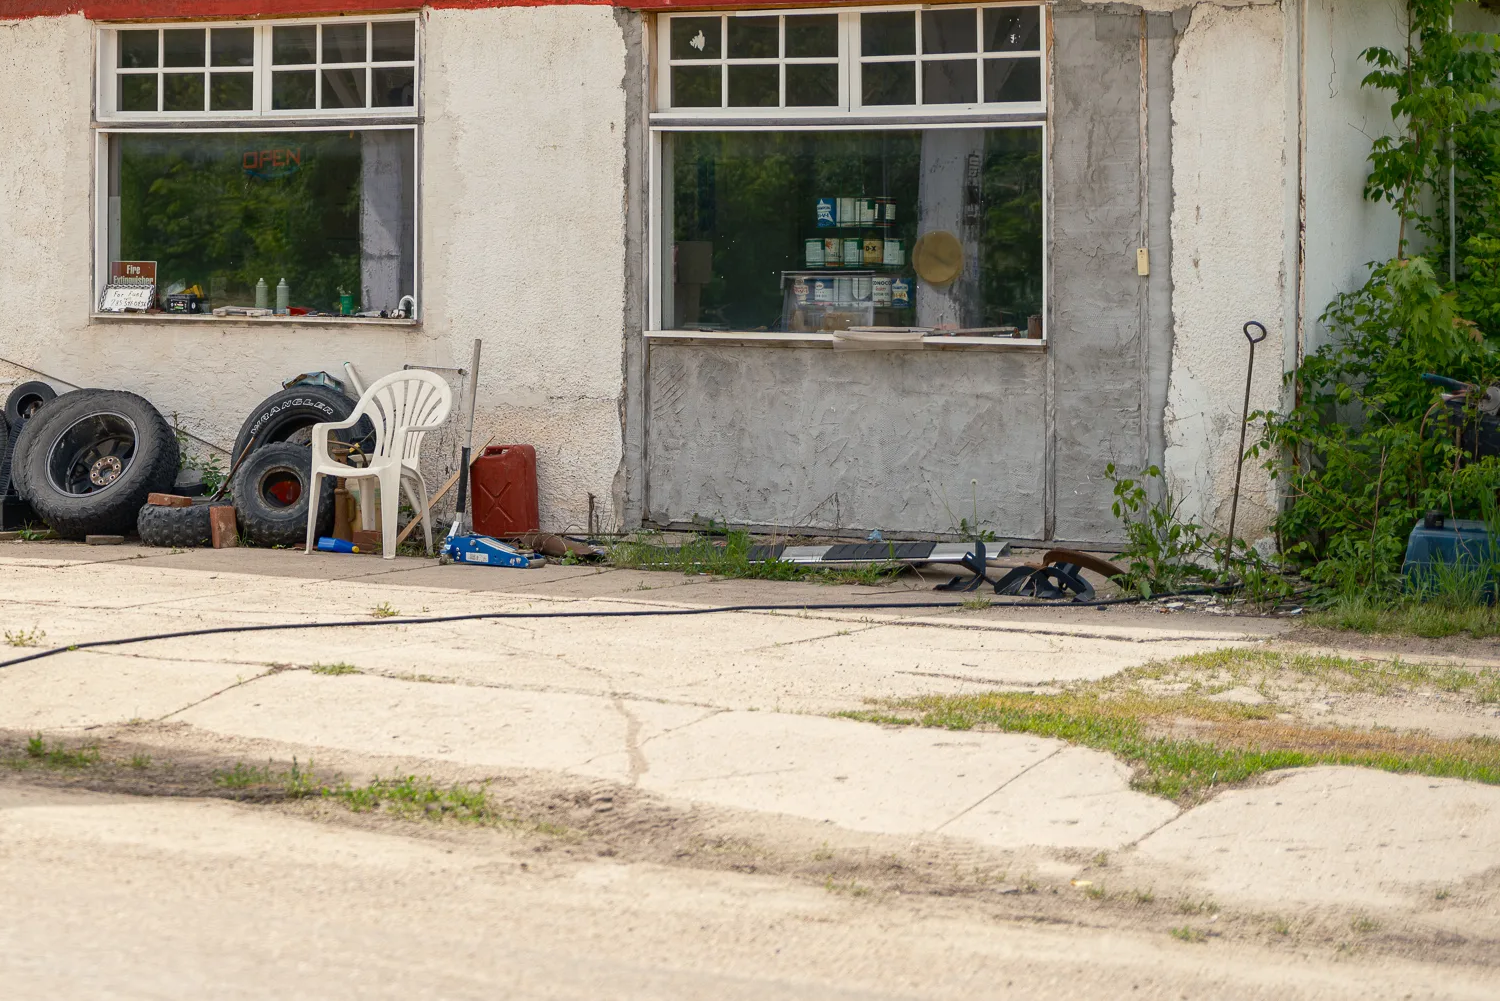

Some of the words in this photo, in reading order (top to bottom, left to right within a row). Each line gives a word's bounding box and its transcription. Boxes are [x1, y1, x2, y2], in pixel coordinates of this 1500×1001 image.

[243, 148, 301, 169] OPEN
[126, 264, 141, 275] Fire
[113, 275, 154, 285] Extinguisher
[250, 398, 334, 435] WRANGLER
